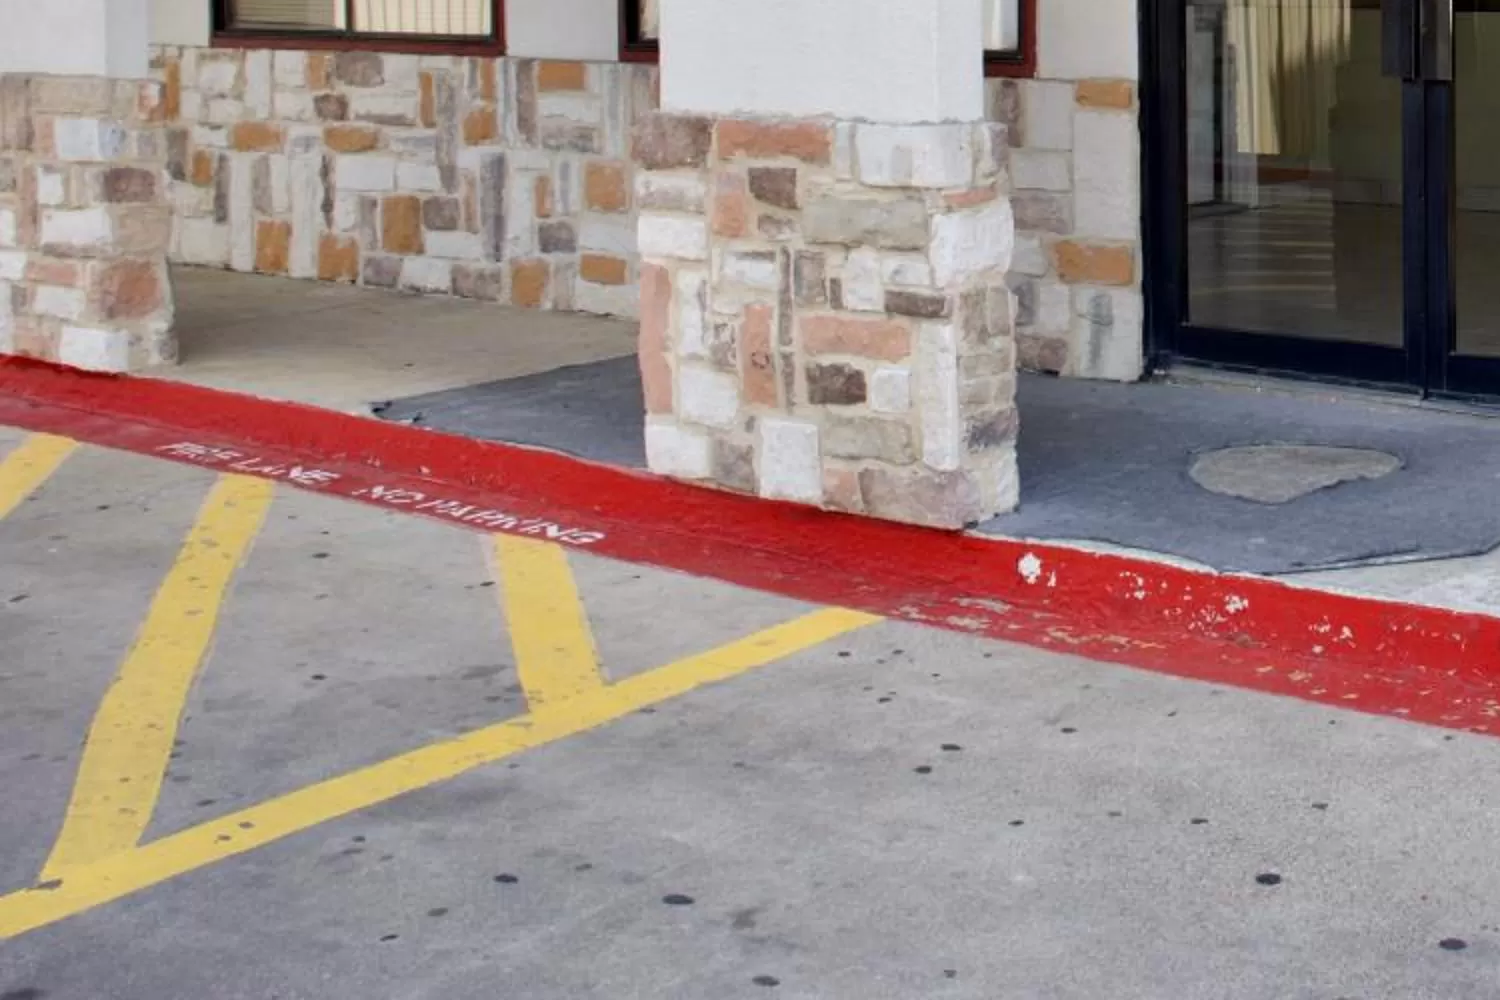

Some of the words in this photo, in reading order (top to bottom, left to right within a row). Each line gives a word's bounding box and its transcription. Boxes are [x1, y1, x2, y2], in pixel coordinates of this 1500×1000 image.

[229, 457, 341, 487] LANE
[352, 484, 426, 504] NO
[416, 499, 606, 545] PARKING
